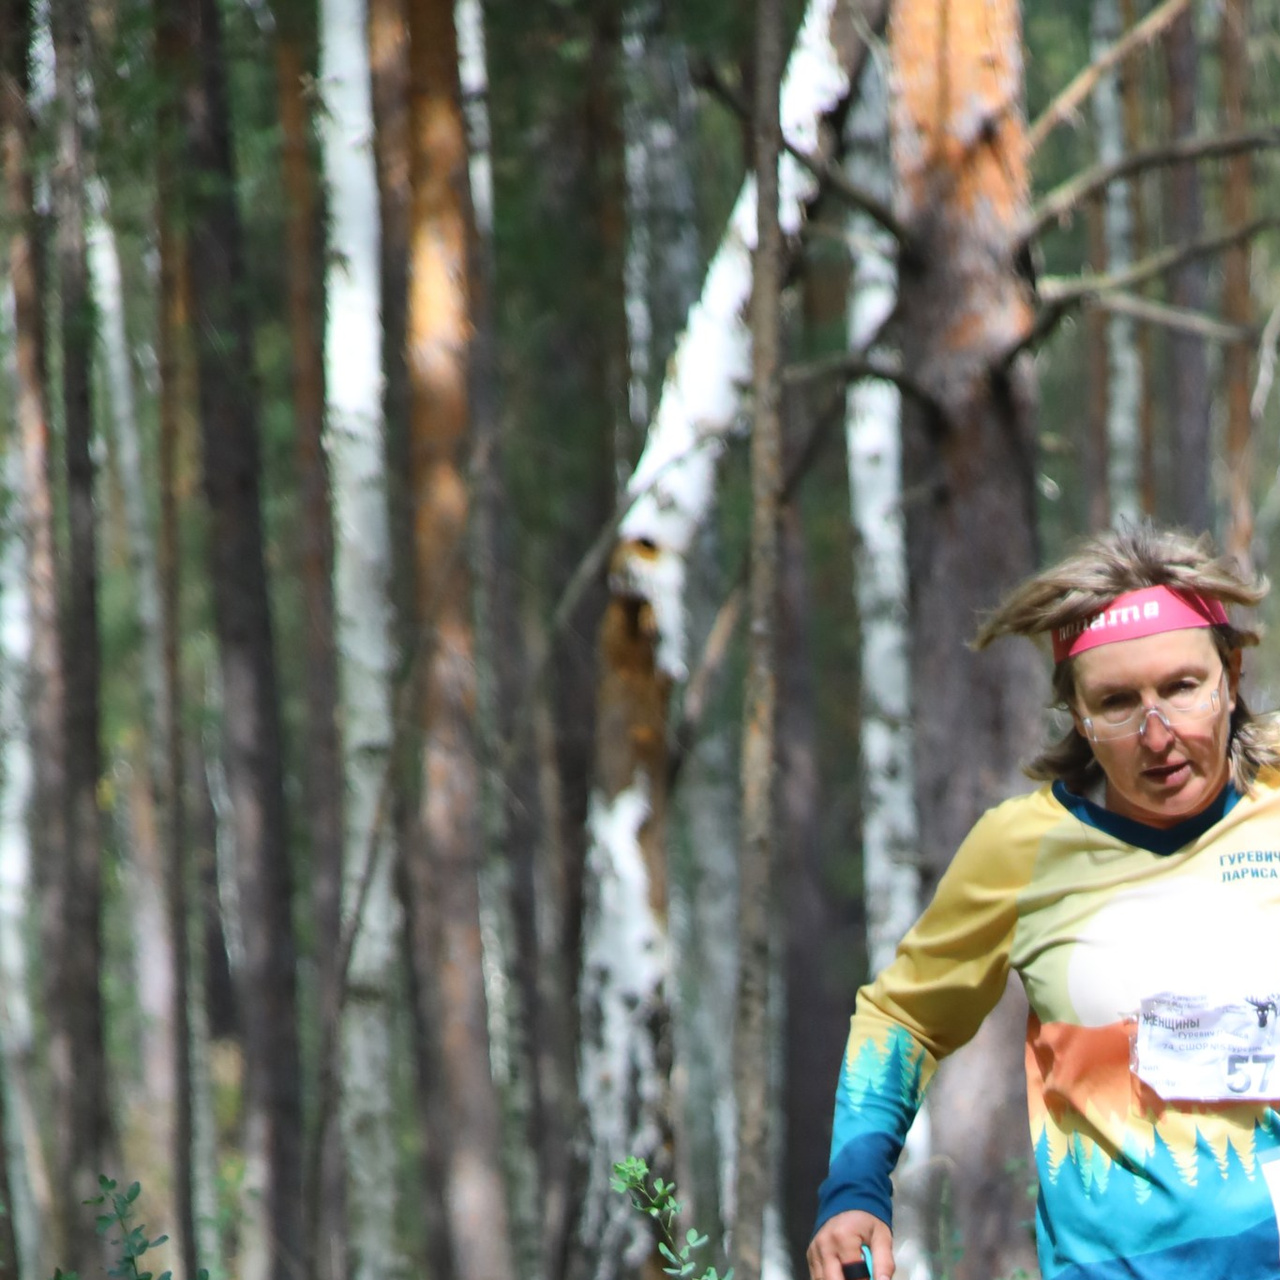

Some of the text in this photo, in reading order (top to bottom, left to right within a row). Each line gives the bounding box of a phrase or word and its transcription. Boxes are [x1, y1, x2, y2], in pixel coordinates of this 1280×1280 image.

[1221, 867, 1278, 883] ЛАРИСА
[1142, 1013, 1200, 1031] ЖЕНЩИНЫ
[1226, 1053, 1277, 1094] 57
